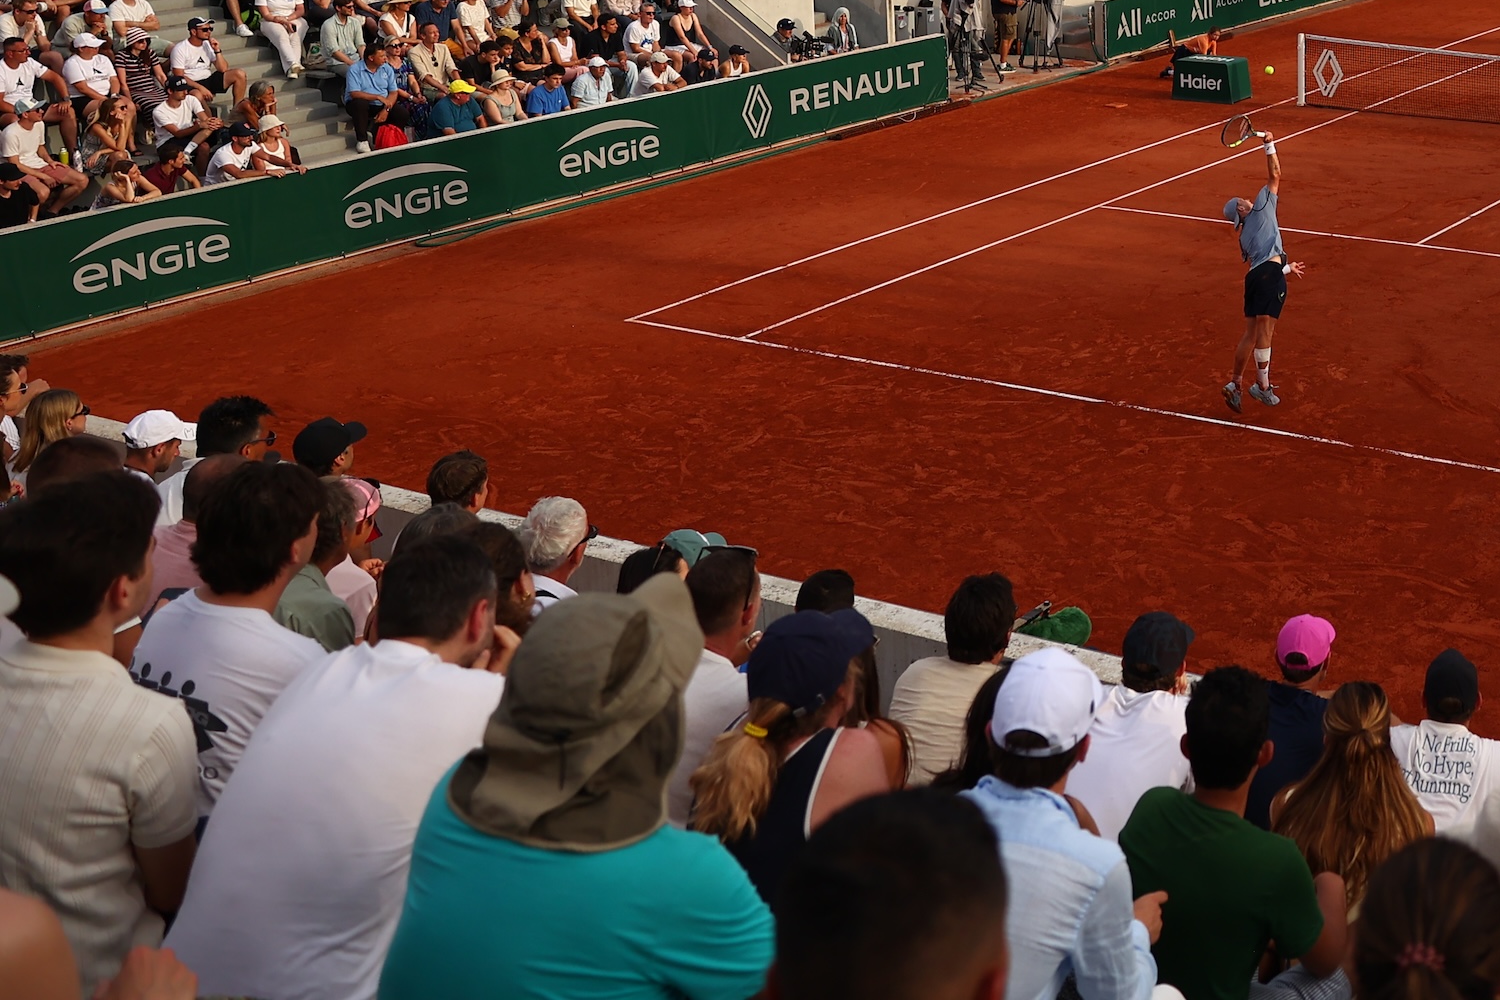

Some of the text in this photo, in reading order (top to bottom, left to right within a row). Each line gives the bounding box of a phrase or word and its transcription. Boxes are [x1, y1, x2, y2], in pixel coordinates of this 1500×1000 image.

[1116, 8, 1176, 40] All ACCOR
[790, 61, 925, 115] RENAULT
[1179, 73, 1222, 91] Haier
[1422, 733, 1476, 758] No Frills,
[1413, 748, 1432, 773] No
[1433, 755, 1474, 780] Hype,
[1411, 771, 1471, 804] Running.
